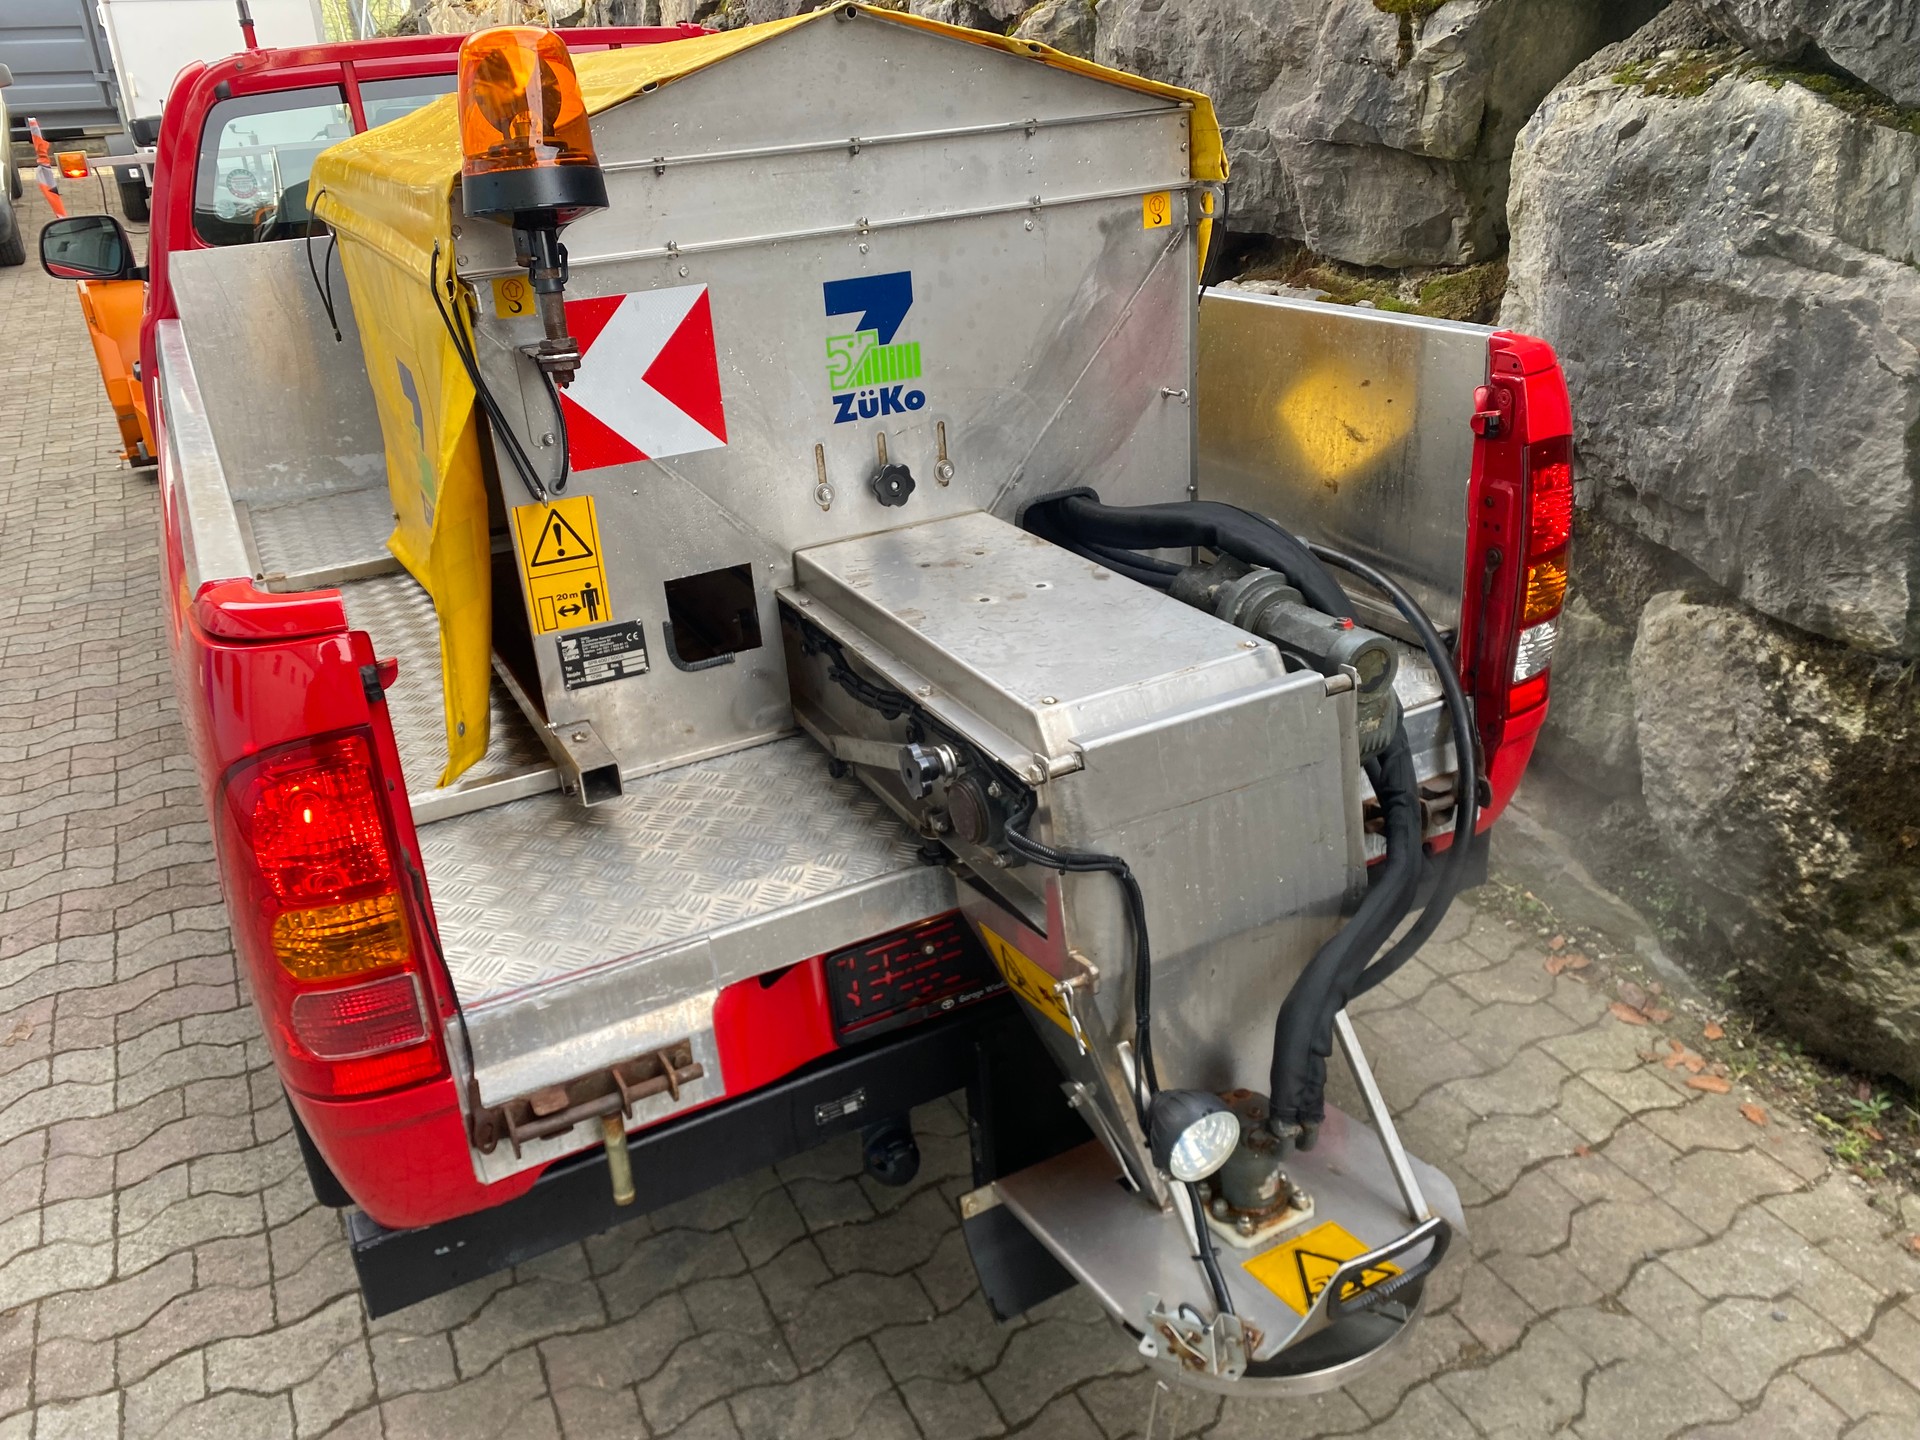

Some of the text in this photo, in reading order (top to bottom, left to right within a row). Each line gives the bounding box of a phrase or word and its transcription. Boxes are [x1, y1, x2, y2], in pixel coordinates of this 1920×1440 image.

[832, 385, 926, 424] ZüKo
[556, 593, 568, 601] 20
[626, 631, 639, 642] CE
